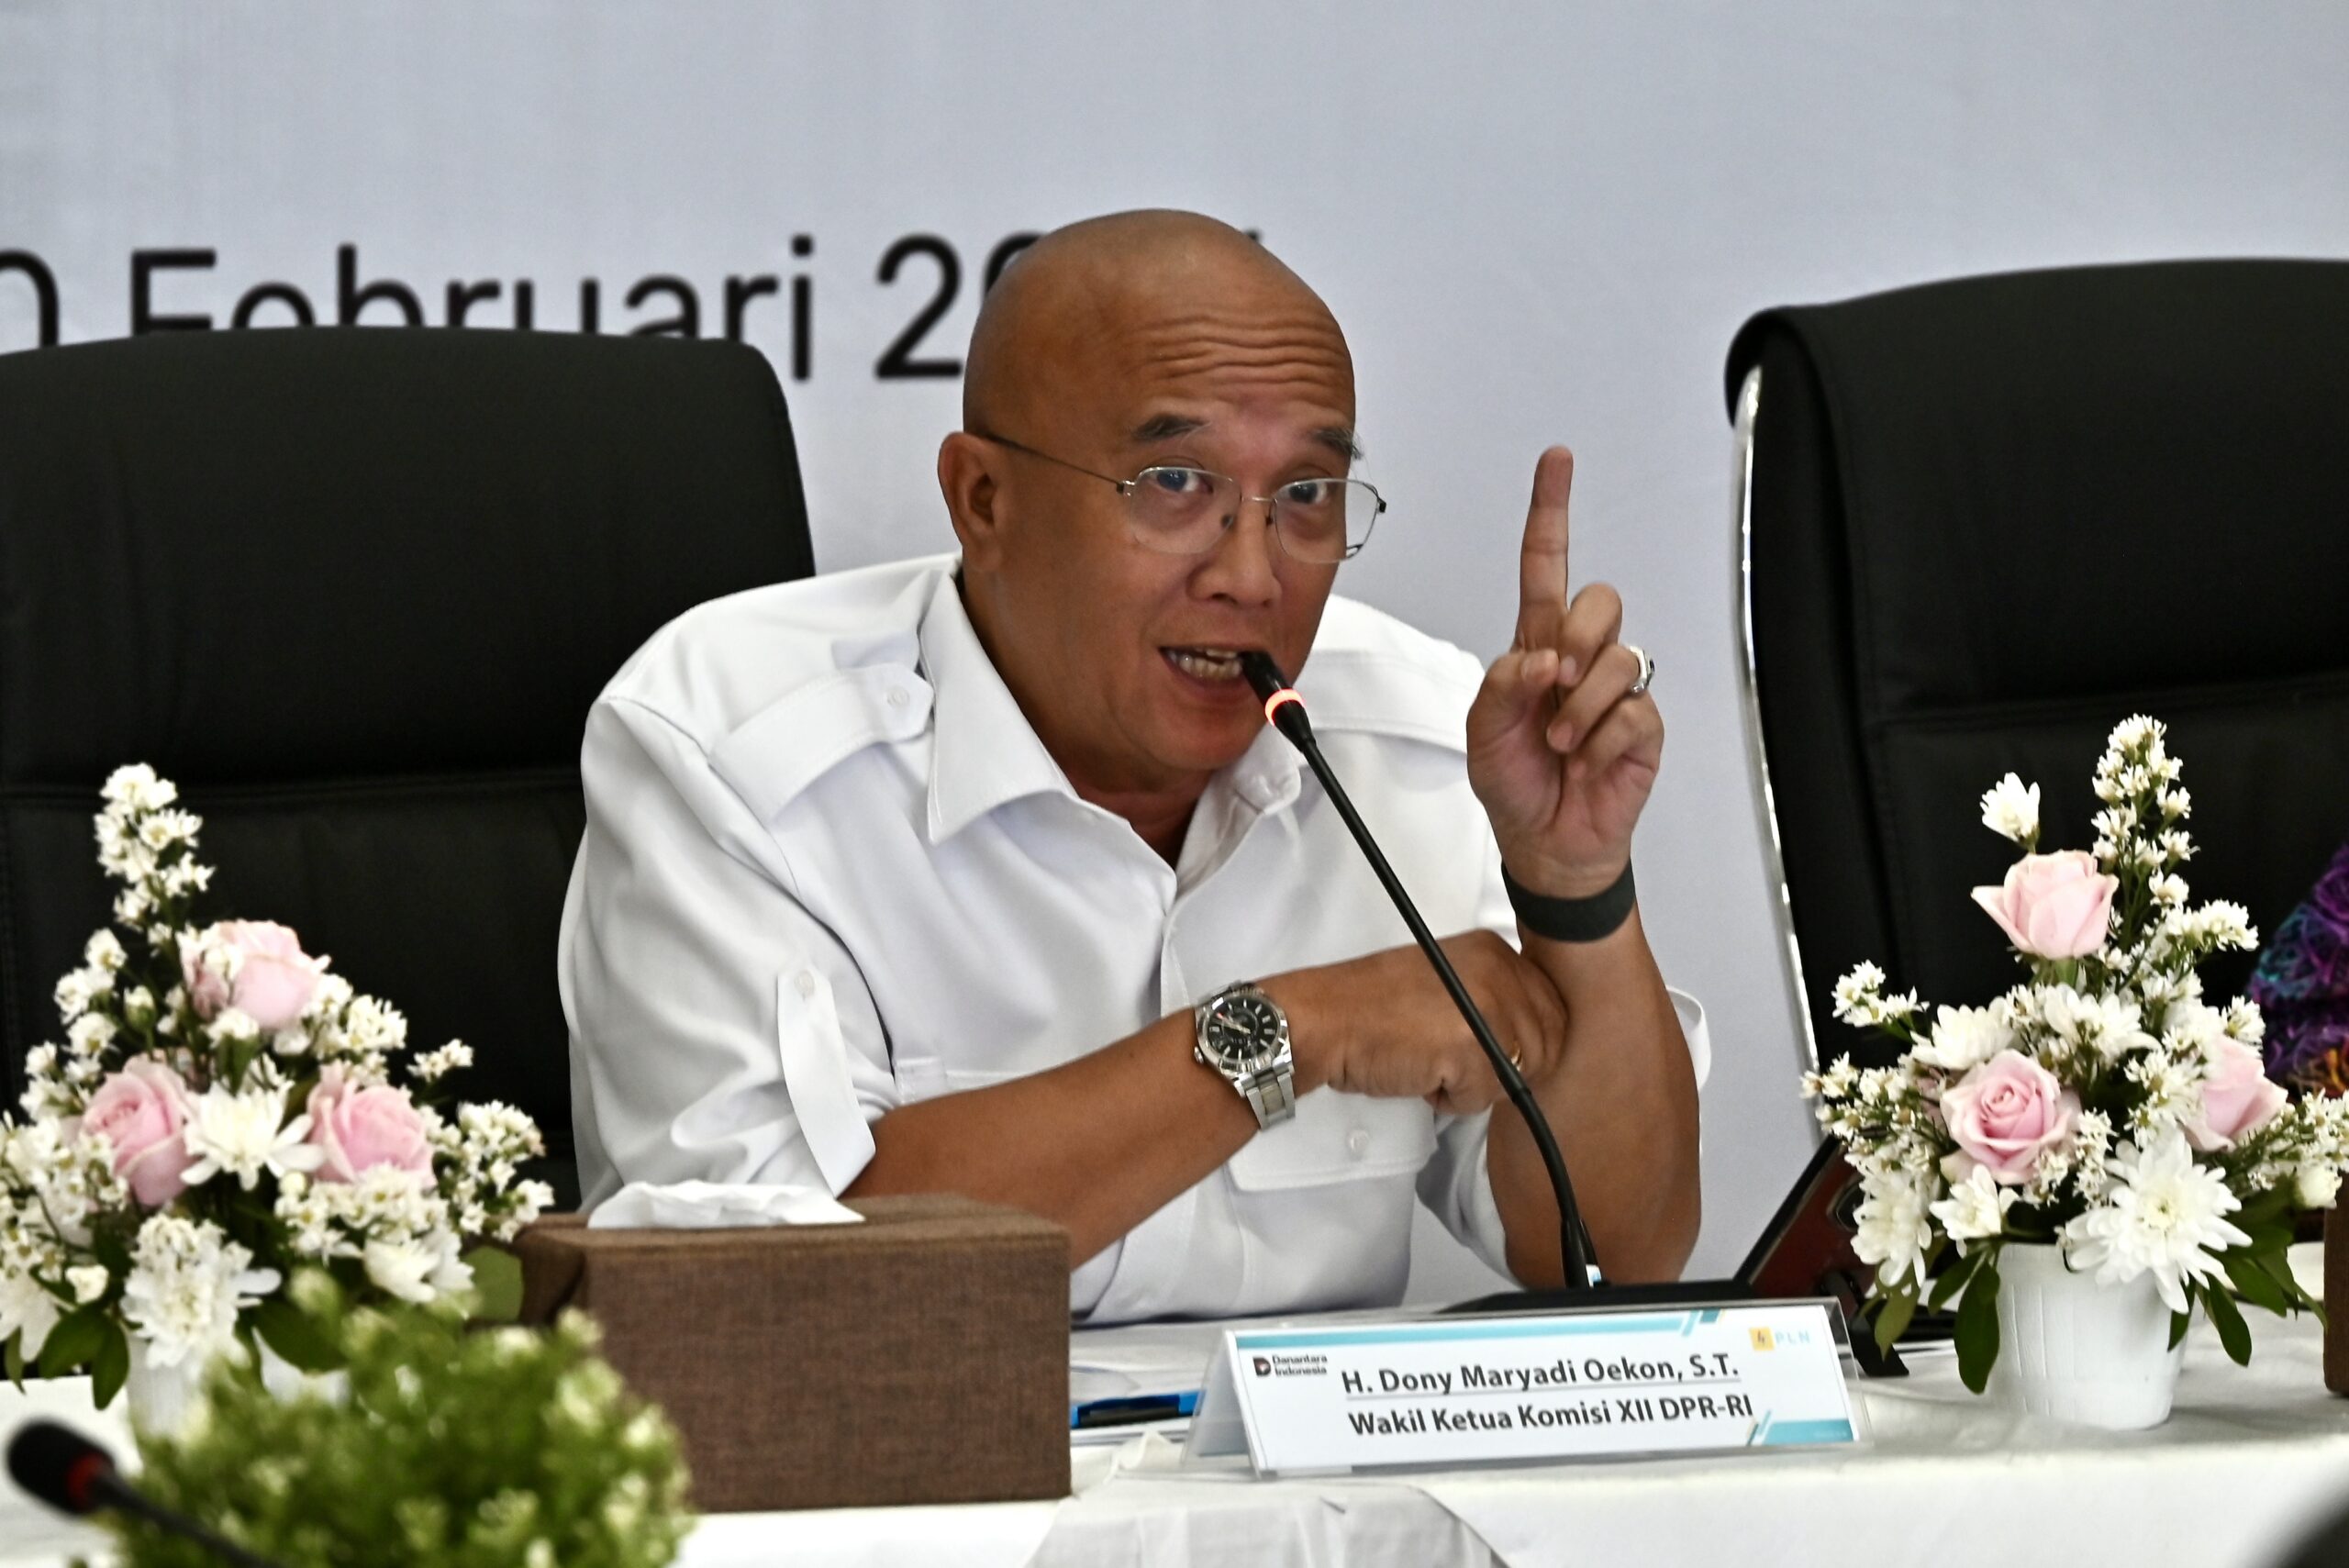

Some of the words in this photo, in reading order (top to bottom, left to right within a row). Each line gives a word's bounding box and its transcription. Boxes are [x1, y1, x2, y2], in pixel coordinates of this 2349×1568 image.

[1776, 1330, 1810, 1345] PLN
[1275, 1365, 1328, 1376] Indonesia
[1341, 1371, 1373, 1394] H.
[1378, 1369, 1453, 1396] Dony
[1460, 1360, 1577, 1392] Maryadi
[1584, 1357, 1683, 1383] Oekon,
[1689, 1353, 1739, 1377] S.T.
[1348, 1408, 1427, 1435] Wakil
[1431, 1408, 1513, 1431] Ketua
[1518, 1400, 1611, 1428] Komisi
[1616, 1399, 1653, 1422] XII
[1659, 1394, 1753, 1420] DPR-RI
